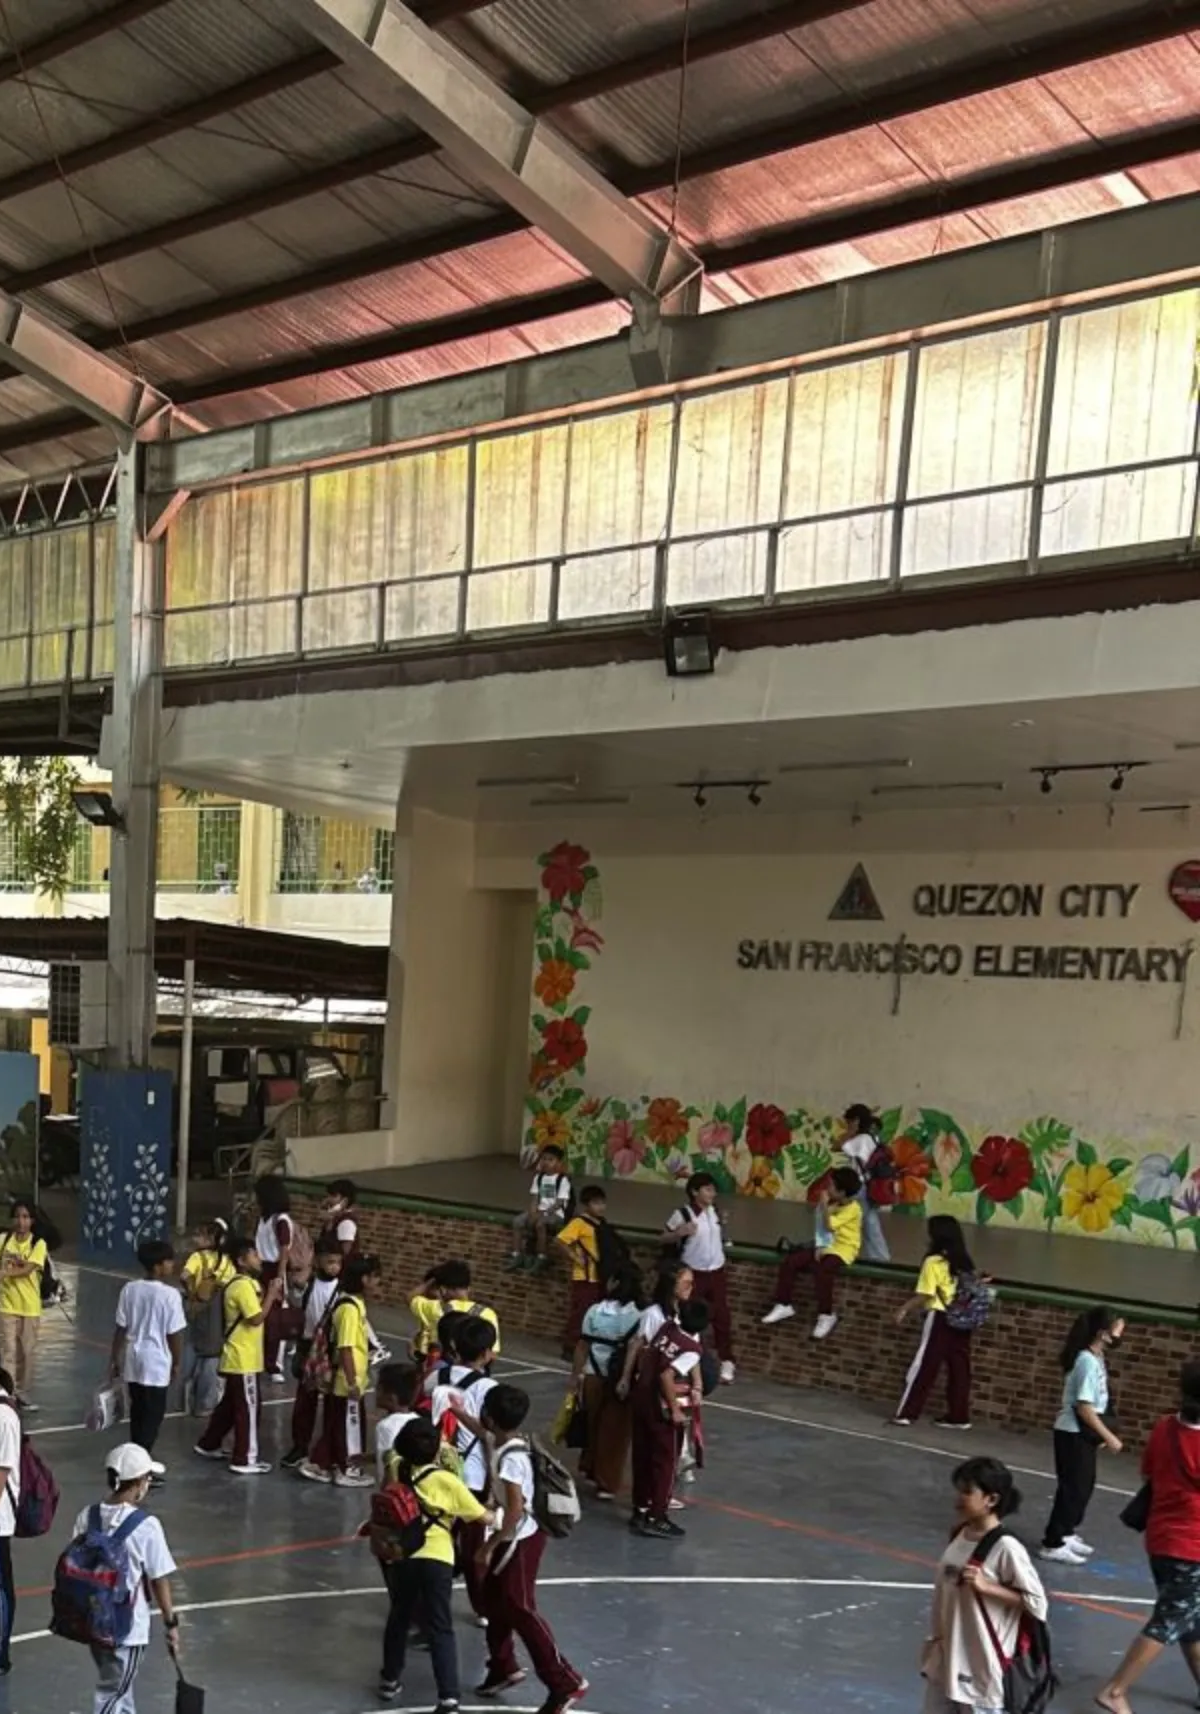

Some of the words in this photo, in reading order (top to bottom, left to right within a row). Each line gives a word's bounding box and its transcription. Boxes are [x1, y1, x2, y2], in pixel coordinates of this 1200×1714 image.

[913, 884, 1044, 918] QUEZON
[1059, 883, 1140, 918] CITY
[737, 940, 792, 971] SAN
[799, 940, 961, 976] FRANCISCO
[973, 944, 1193, 982] ELEMENTARY
